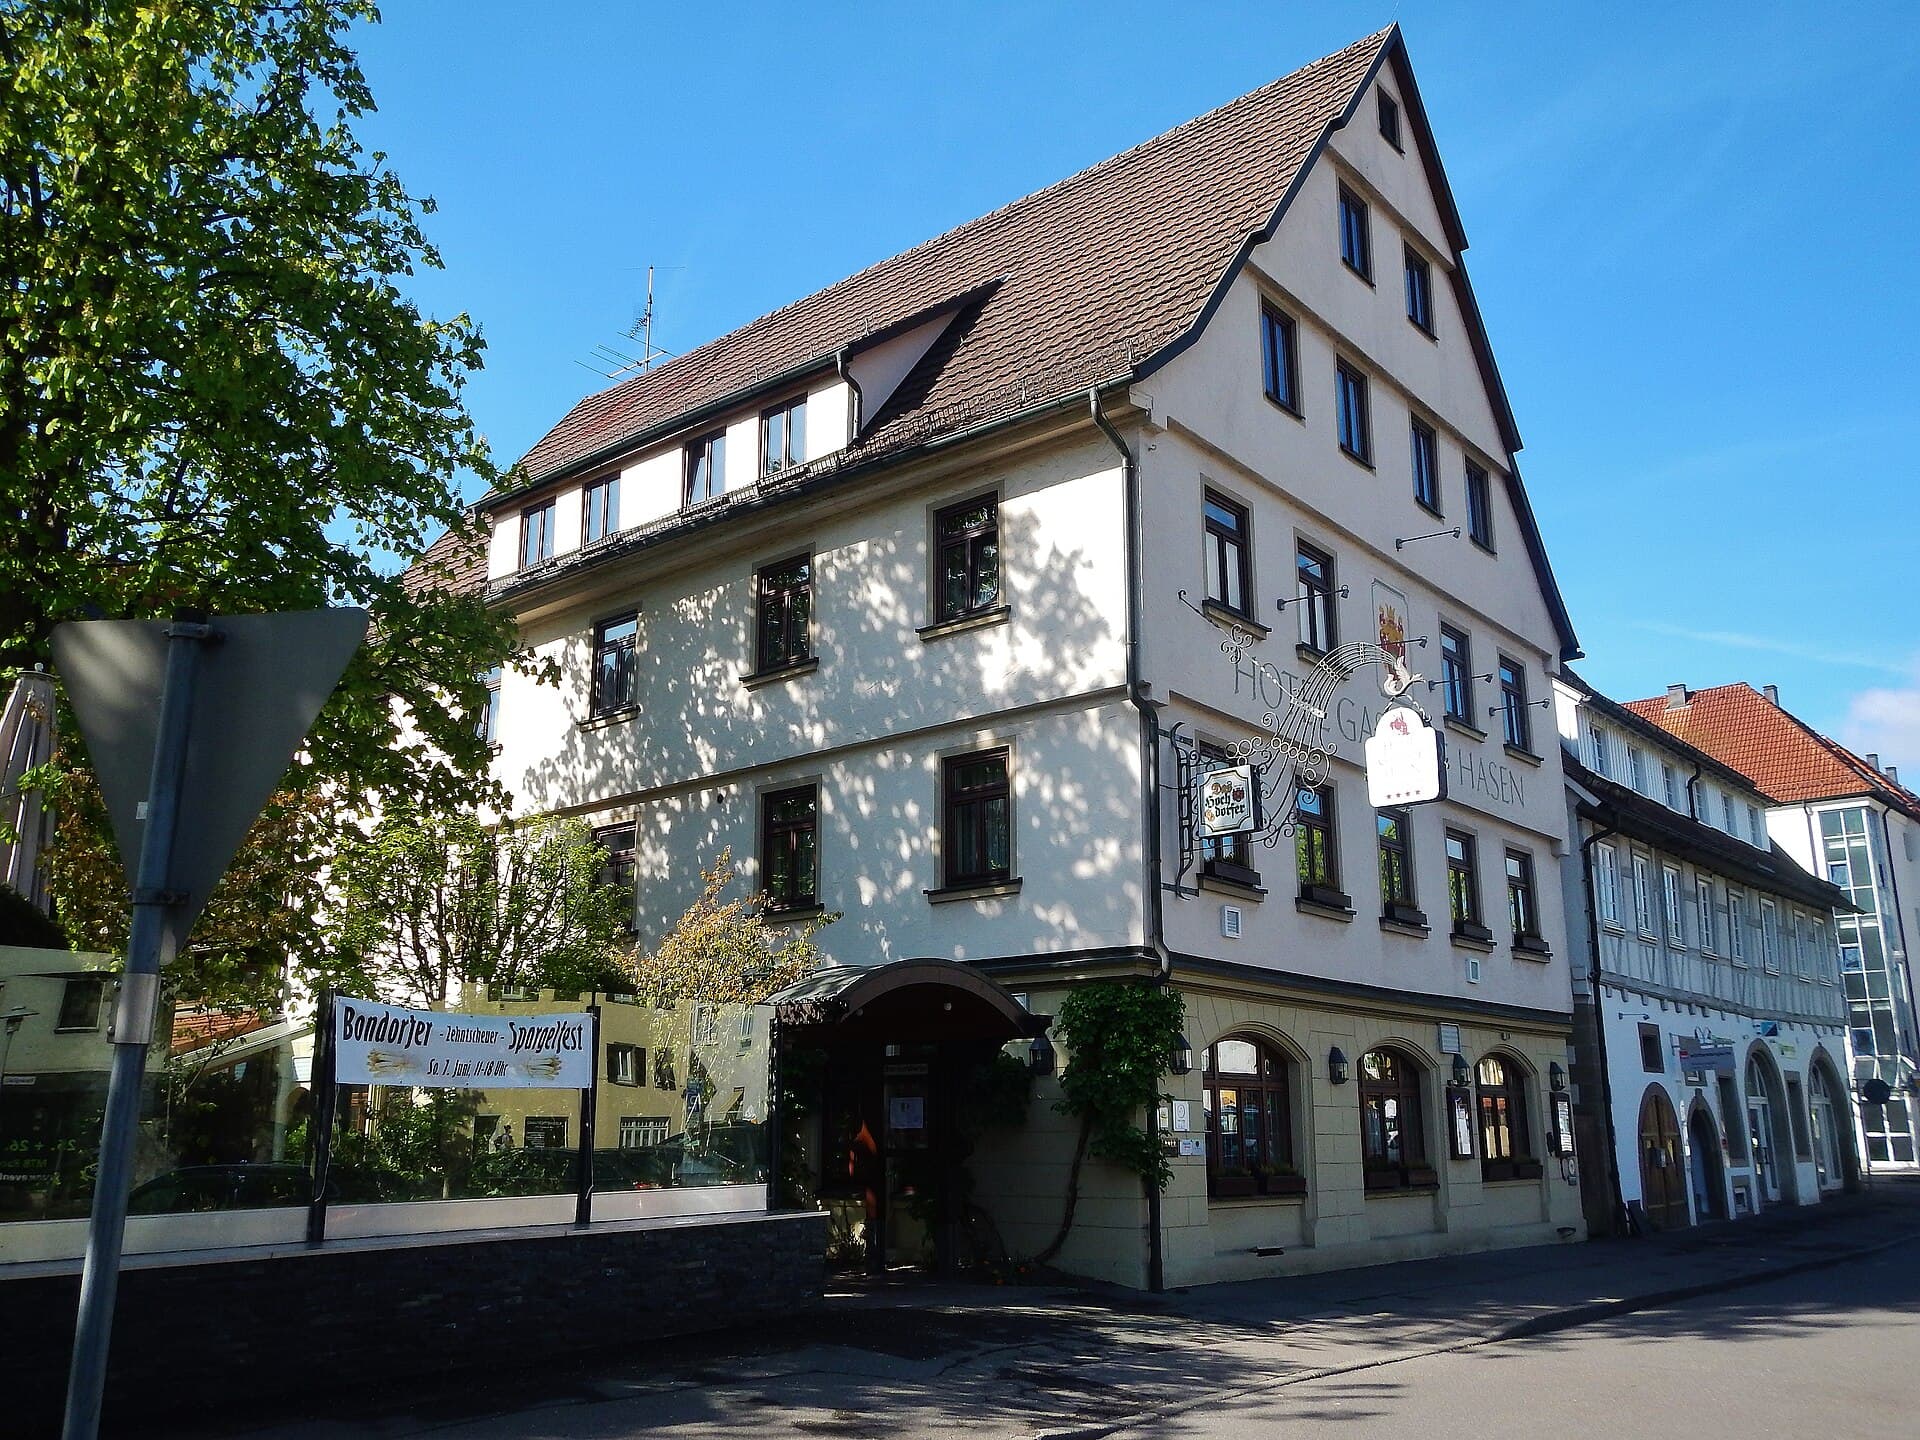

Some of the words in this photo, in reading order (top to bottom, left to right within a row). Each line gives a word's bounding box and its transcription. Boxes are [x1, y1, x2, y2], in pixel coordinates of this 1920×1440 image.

[1458, 747, 1525, 808] HASEN
[1205, 793, 1231, 809] Hoch
[1215, 802, 1246, 819] dorfer
[343, 1006, 433, 1050] Bondorfer
[446, 1025, 498, 1044] Zehntscheuer
[508, 1021, 583, 1054] Spargelfest
[427, 1058, 439, 1076] So.
[452, 1060, 471, 1078] Juni,
[474, 1060, 494, 1077] 11-18
[494, 1060, 508, 1077] Uhr
